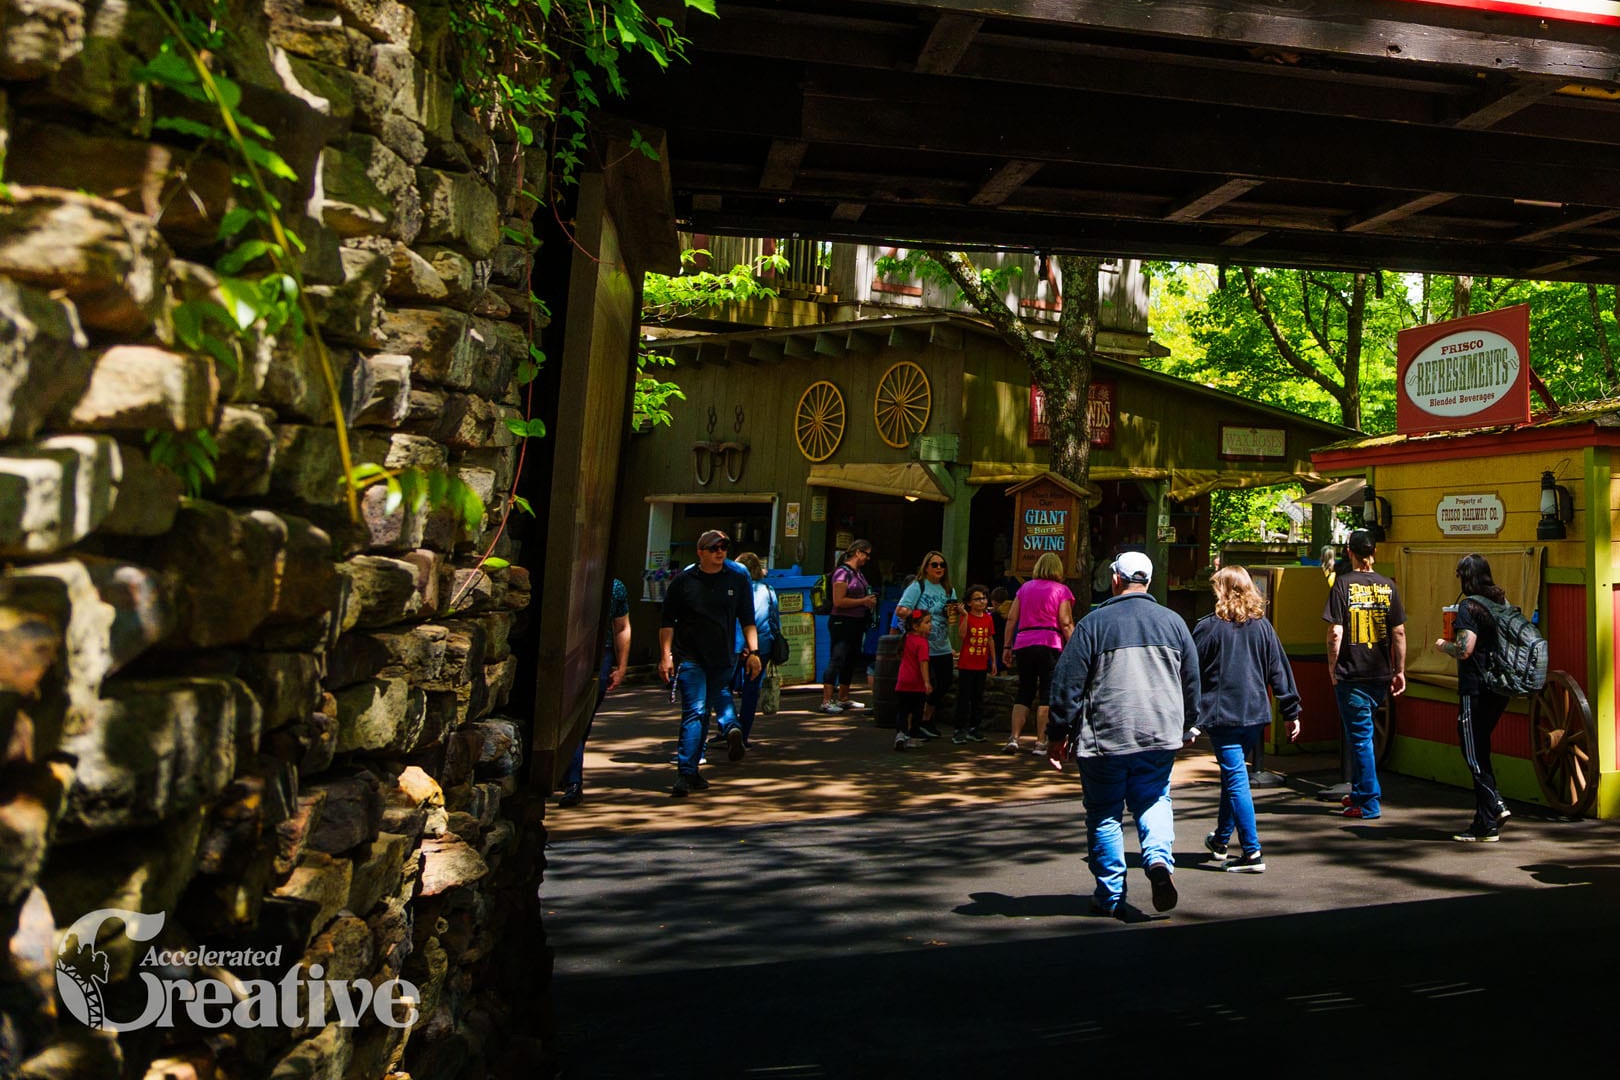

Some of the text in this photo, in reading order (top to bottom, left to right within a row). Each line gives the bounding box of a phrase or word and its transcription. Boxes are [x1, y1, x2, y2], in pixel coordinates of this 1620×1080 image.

[1440, 339, 1484, 355] FRISCO
[1416, 347, 1509, 397] REFRESHMENTS
[1429, 392, 1495, 407] Blended Beverages
[1025, 508, 1068, 526] GIANT
[1442, 508, 1460, 521] FRISCO
[1462, 507, 1488, 521] RAILWAY
[1023, 535, 1066, 551] SWING
